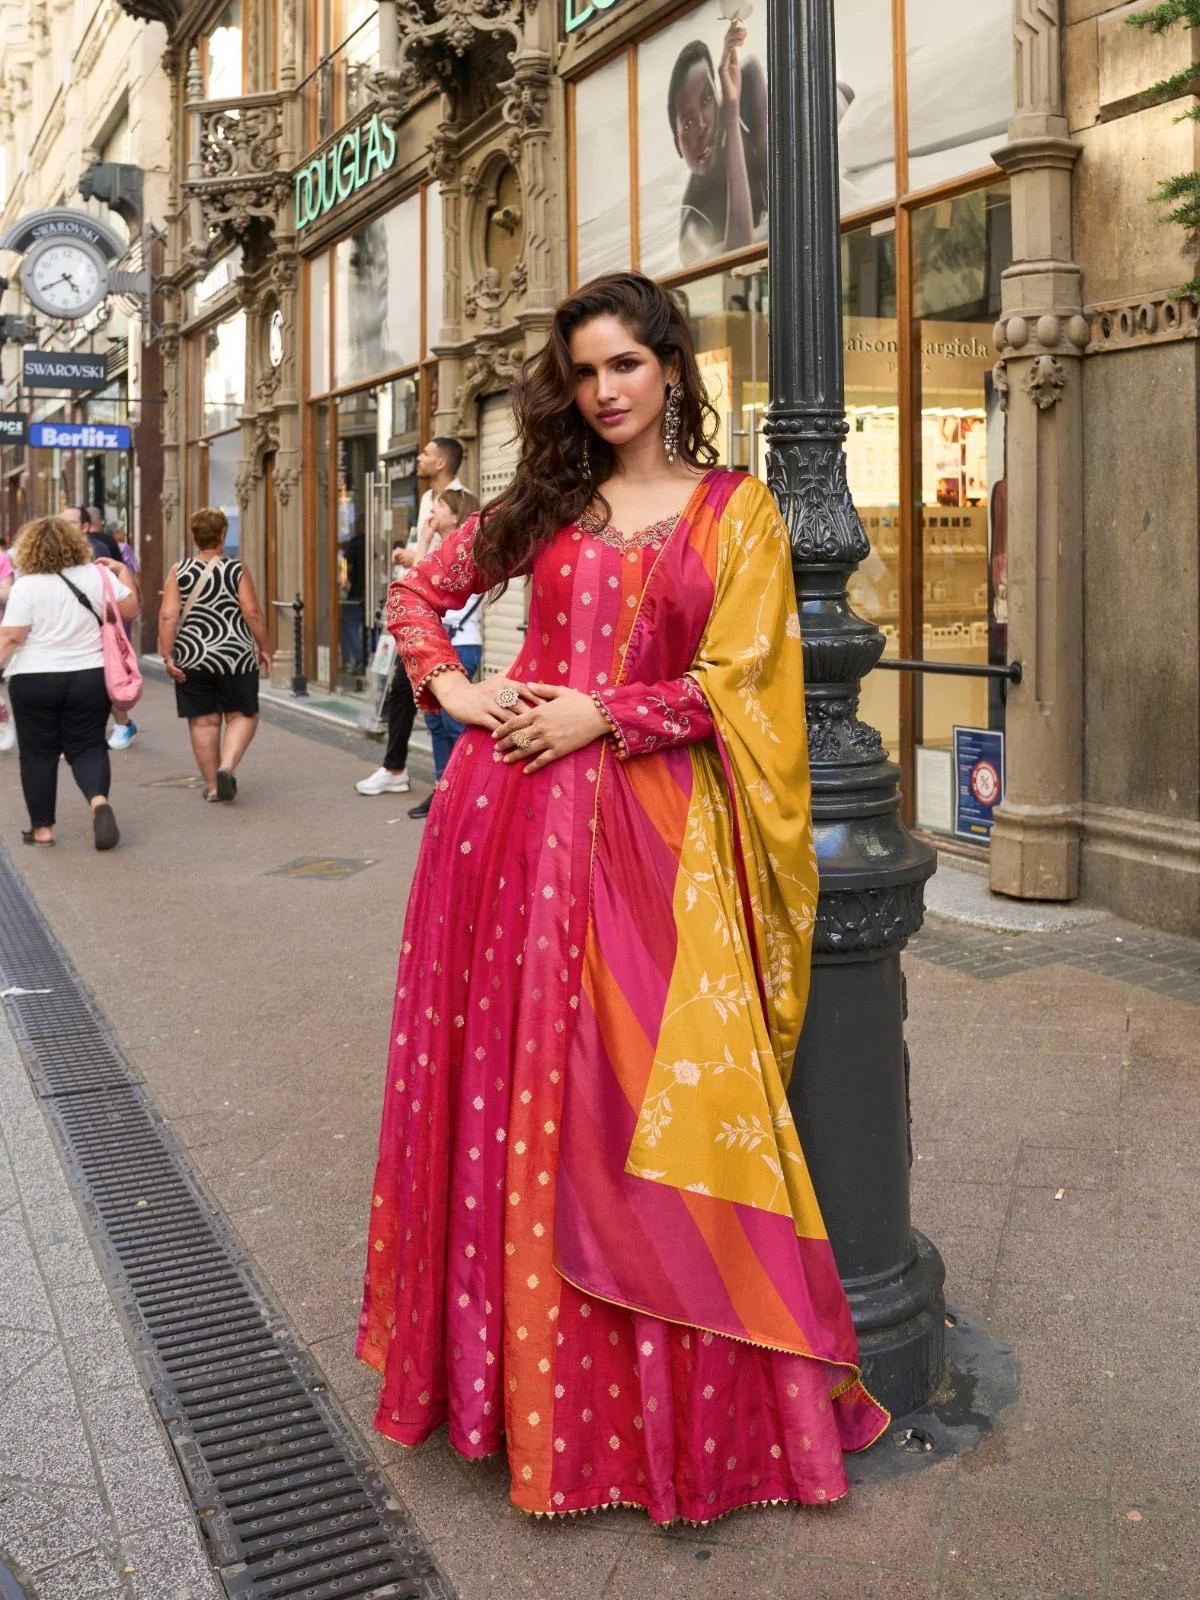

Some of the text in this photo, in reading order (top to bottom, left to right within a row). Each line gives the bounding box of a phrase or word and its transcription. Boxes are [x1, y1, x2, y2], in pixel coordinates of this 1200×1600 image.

[295, 113, 396, 230] DOUGLAS
[32, 222, 100, 243] SWAROVSKI
[847, 333, 989, 359] aison argiela
[25, 362, 104, 379] SWAROVSKI
[41, 426, 118, 448] Berlitz
